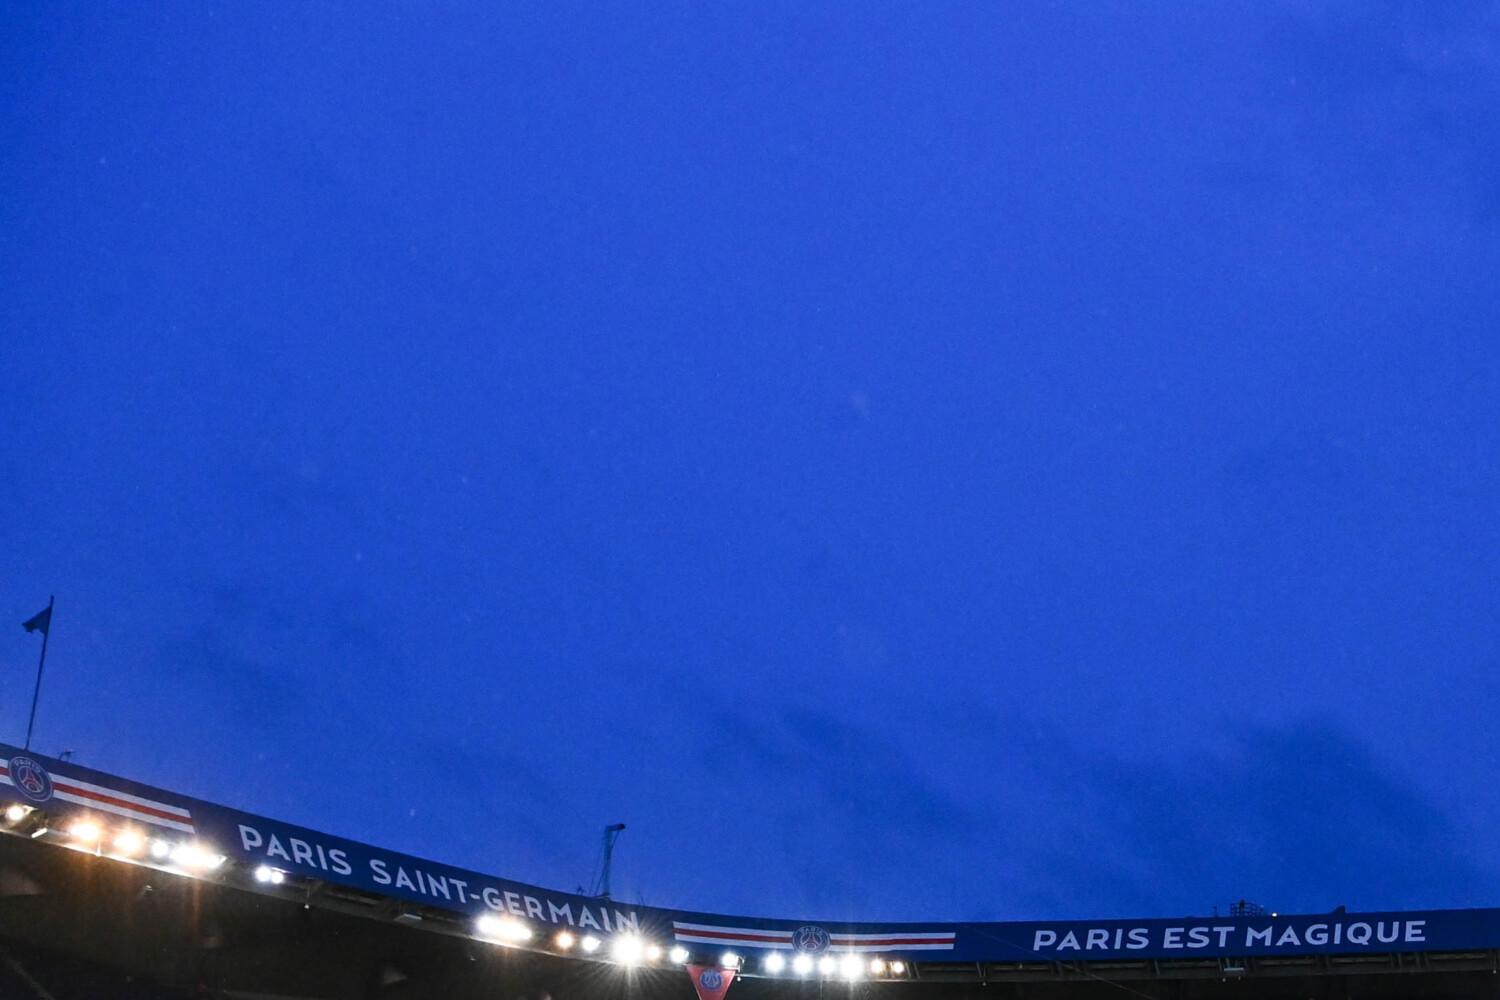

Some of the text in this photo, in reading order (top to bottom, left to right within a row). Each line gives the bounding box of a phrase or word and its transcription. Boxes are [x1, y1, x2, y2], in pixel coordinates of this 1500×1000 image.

[238, 824, 639, 933] PARIS SAINT-GERMAIN
[1033, 920, 1427, 951] PARIS EST MAGIQUE
